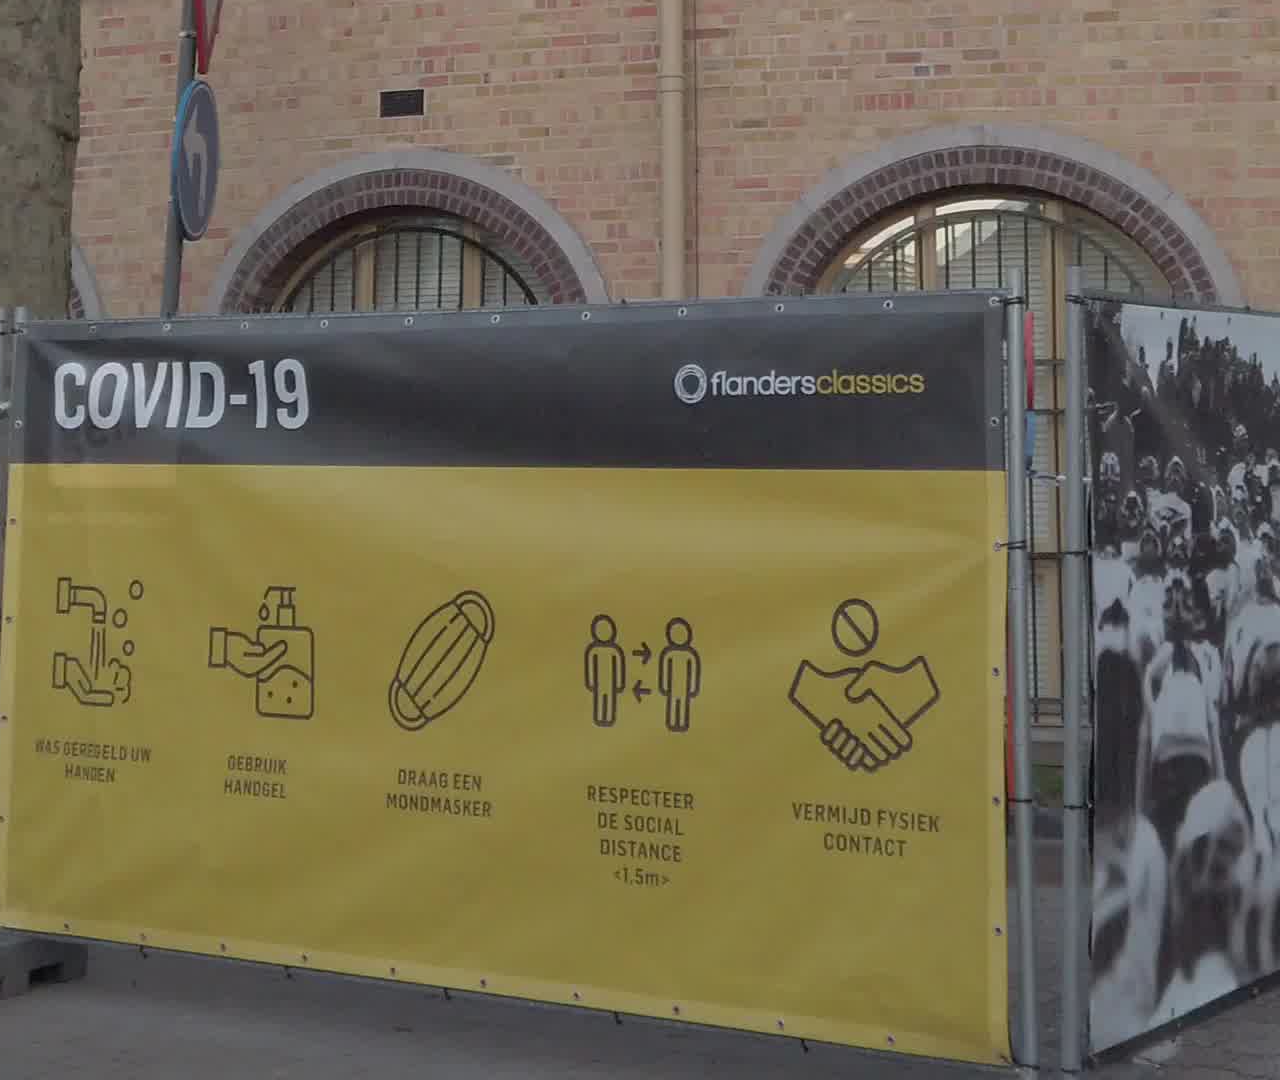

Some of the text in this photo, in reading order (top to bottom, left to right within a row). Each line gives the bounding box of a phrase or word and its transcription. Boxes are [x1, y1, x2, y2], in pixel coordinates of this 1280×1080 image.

[54, 358, 309, 429] COVID-19
[34, 738, 60, 756] WAS
[131, 746, 153, 763] UW
[64, 763, 116, 783] HANDEN
[227, 754, 288, 775] GEBRUIK
[223, 779, 288, 799] HANDGEL
[397, 768, 482, 792] DRAAG EEN
[385, 793, 492, 817] MONDMASKER
[587, 784, 695, 809] RESPECTEER
[598, 811, 685, 836] DE SOCIAL
[791, 801, 940, 833] VERMIJD FYSIEK
[599, 838, 682, 863] DISTANCE
[823, 831, 907, 857] CONTACT
